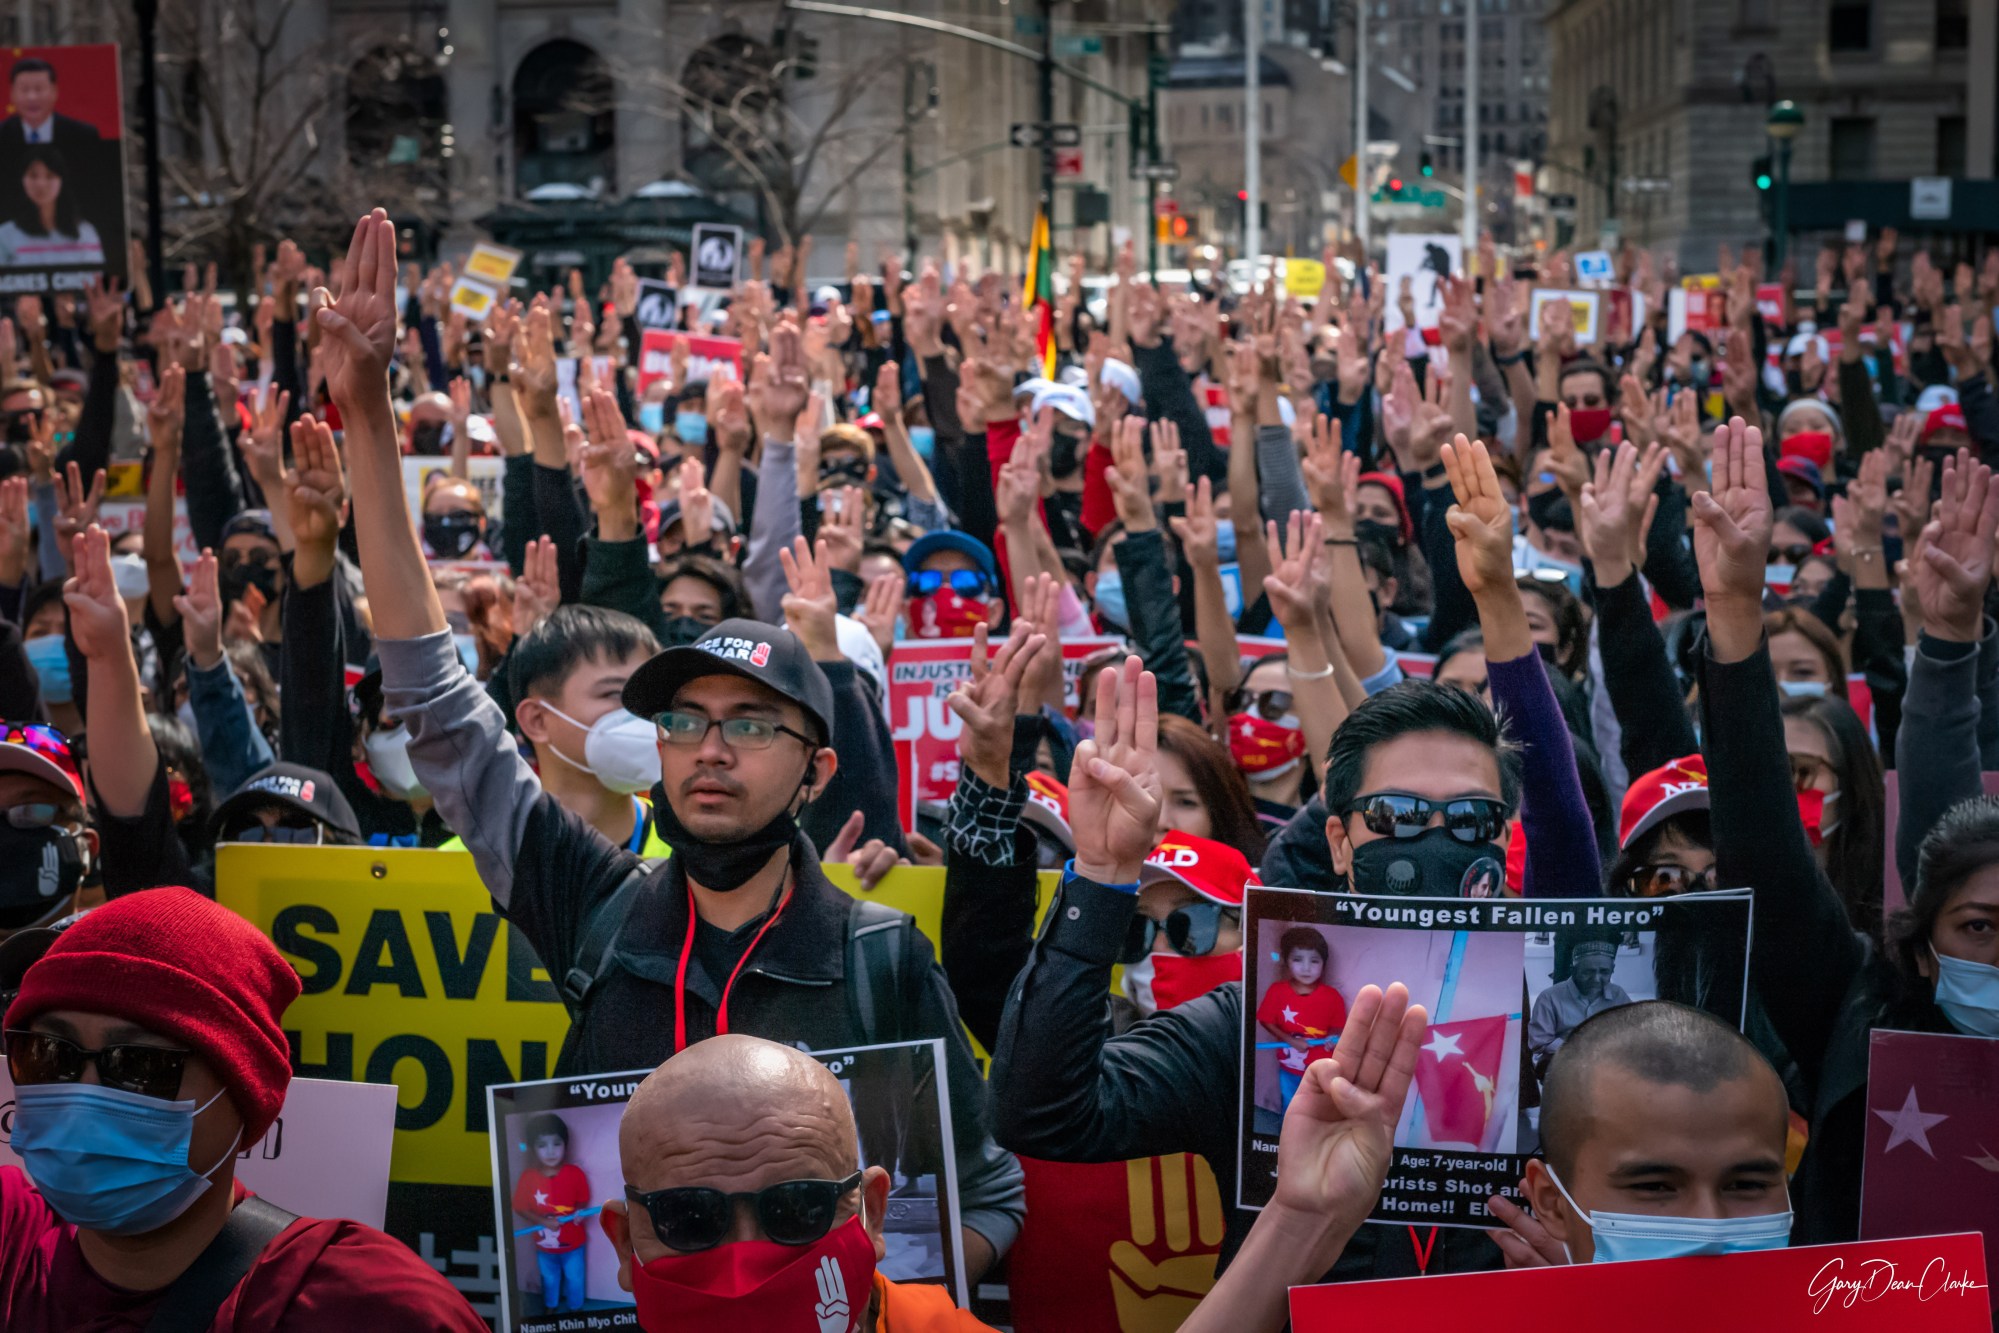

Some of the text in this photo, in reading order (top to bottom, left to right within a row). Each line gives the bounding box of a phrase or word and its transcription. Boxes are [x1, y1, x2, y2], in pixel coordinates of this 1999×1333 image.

[724, 637, 753, 650] FOR
[1146, 849, 1199, 868] LD
[1491, 905, 1575, 925] Fallen
[271, 903, 565, 1004] SAVE
[284, 1030, 548, 1133] HON
[569, 1082, 640, 1100] “Youn
[1252, 1139, 1280, 1153] Nam
[1400, 1153, 1507, 1172] Age: 7-year-old
[1381, 1176, 1438, 1192] orists
[1444, 1179, 1493, 1196] Shot
[1382, 1196, 1455, 1214] Home!!
[520, 1313, 637, 1333] Name: Khin Myo Chit
